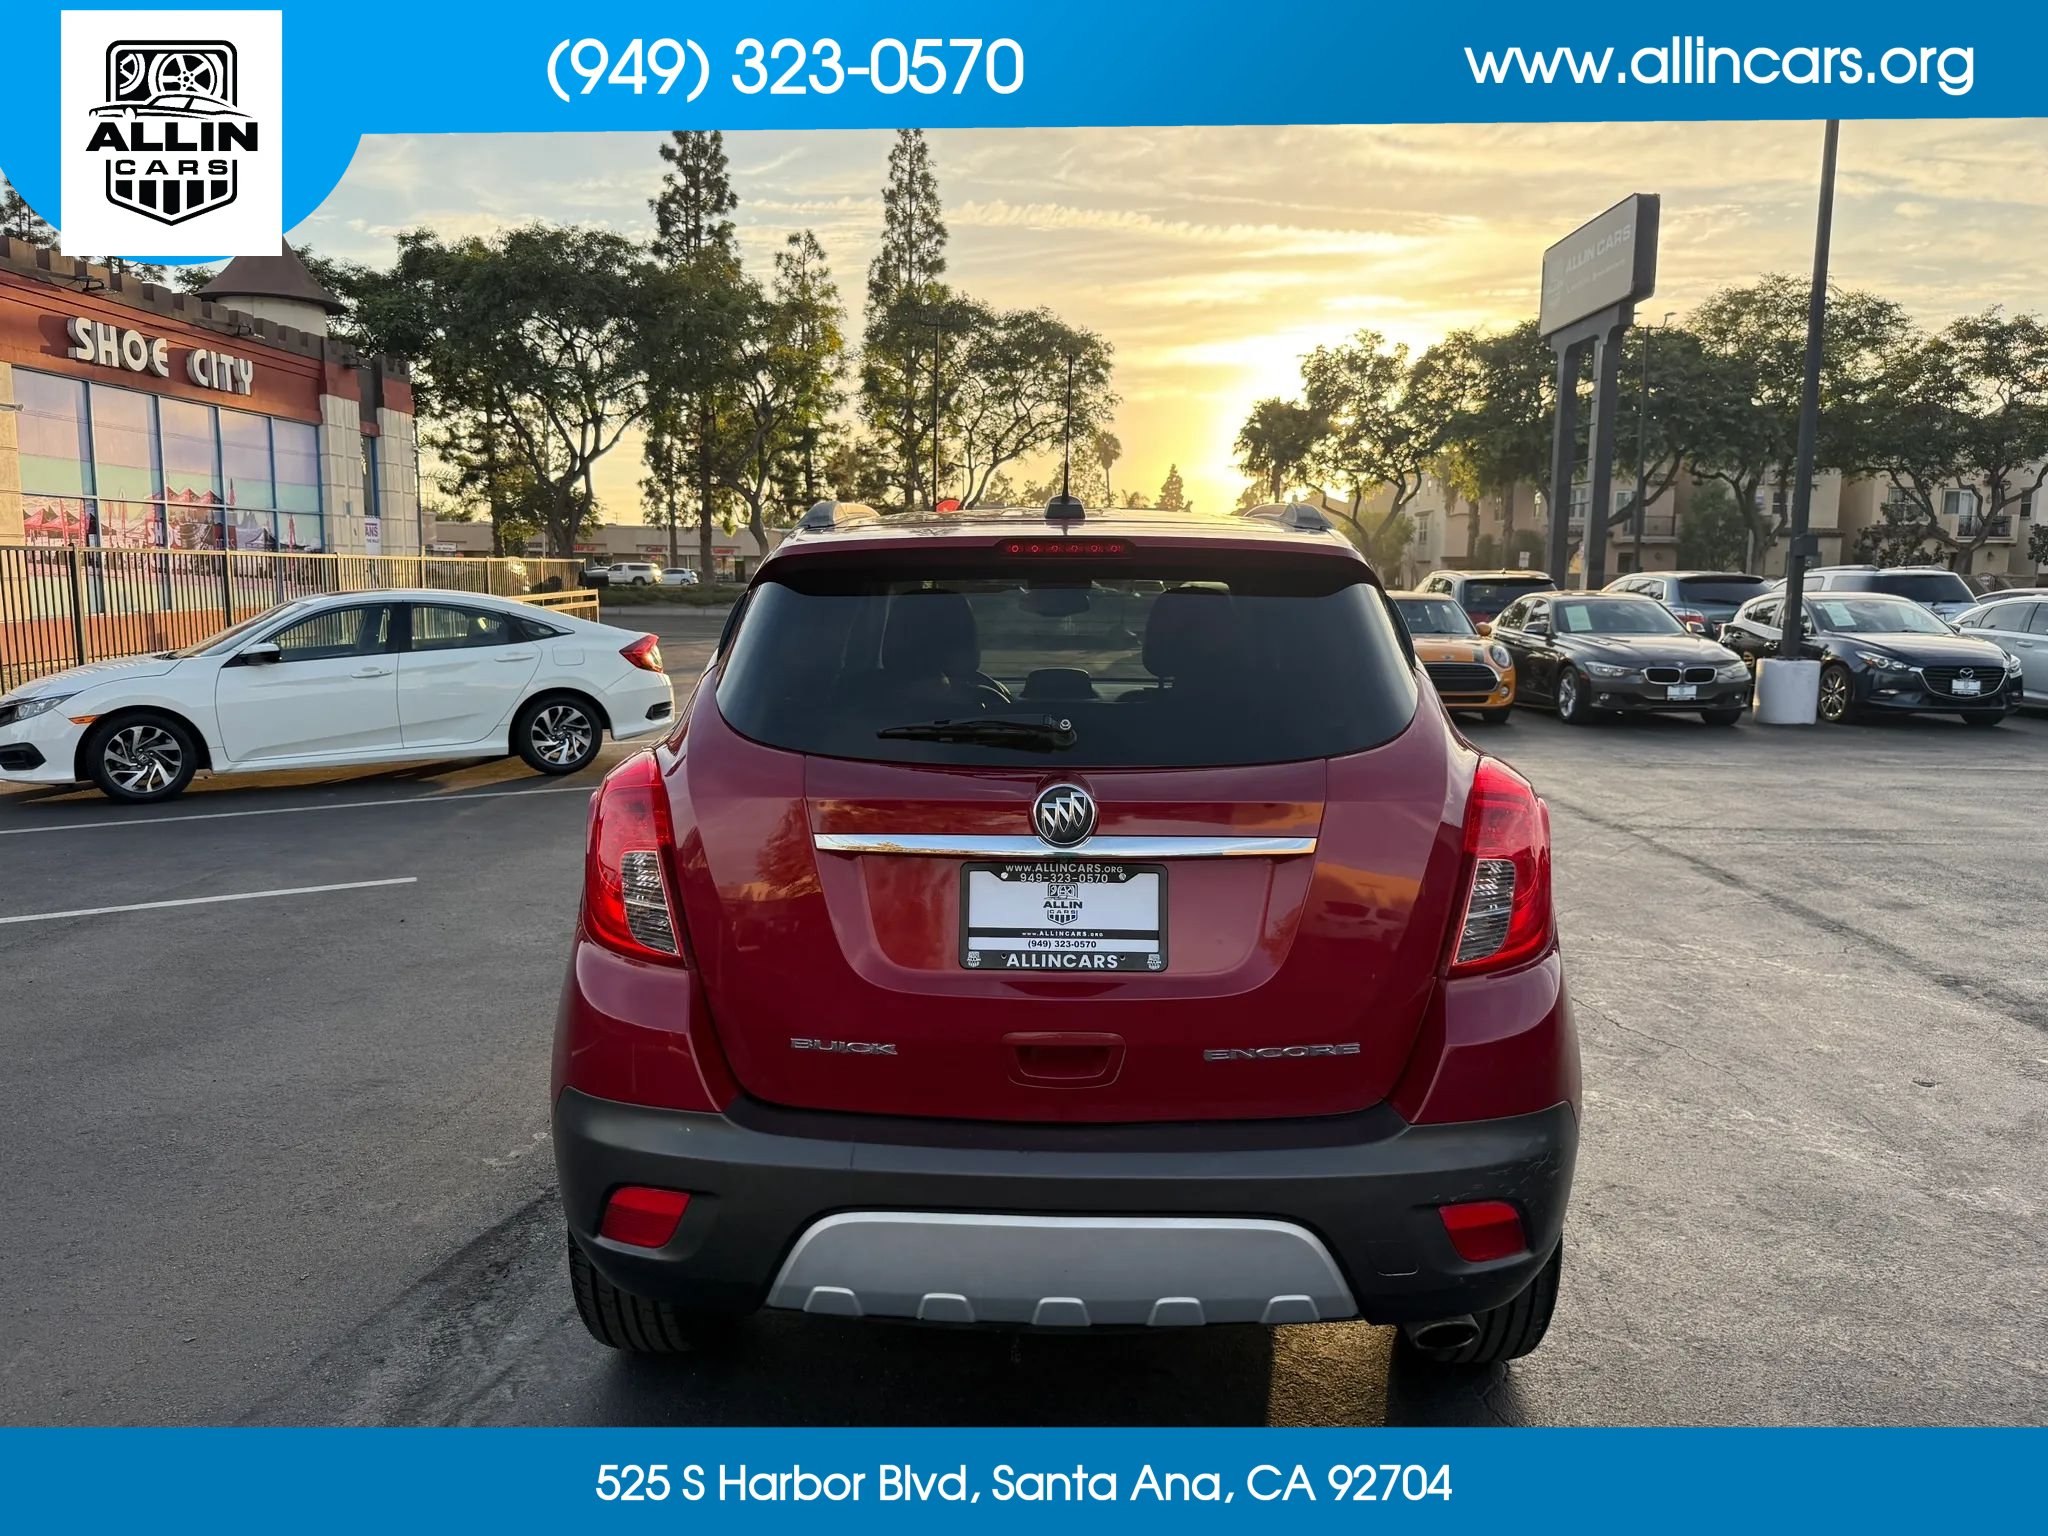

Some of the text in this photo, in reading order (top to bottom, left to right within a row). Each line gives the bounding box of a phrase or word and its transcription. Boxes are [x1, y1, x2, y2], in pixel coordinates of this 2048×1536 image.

[1565, 224, 1632, 273] ALLIN CARS
[68, 316, 254, 396] SHOE CITY
[1020, 873, 1109, 883] 949-323-0570
[1043, 900, 1083, 909] ALLIN
[1028, 939, 1097, 949] (949) 323-0570
[1006, 953, 1119, 969] ALLINCARS
[790, 1037, 898, 1055] BUICK
[1203, 1042, 1361, 1062] ENCORE
